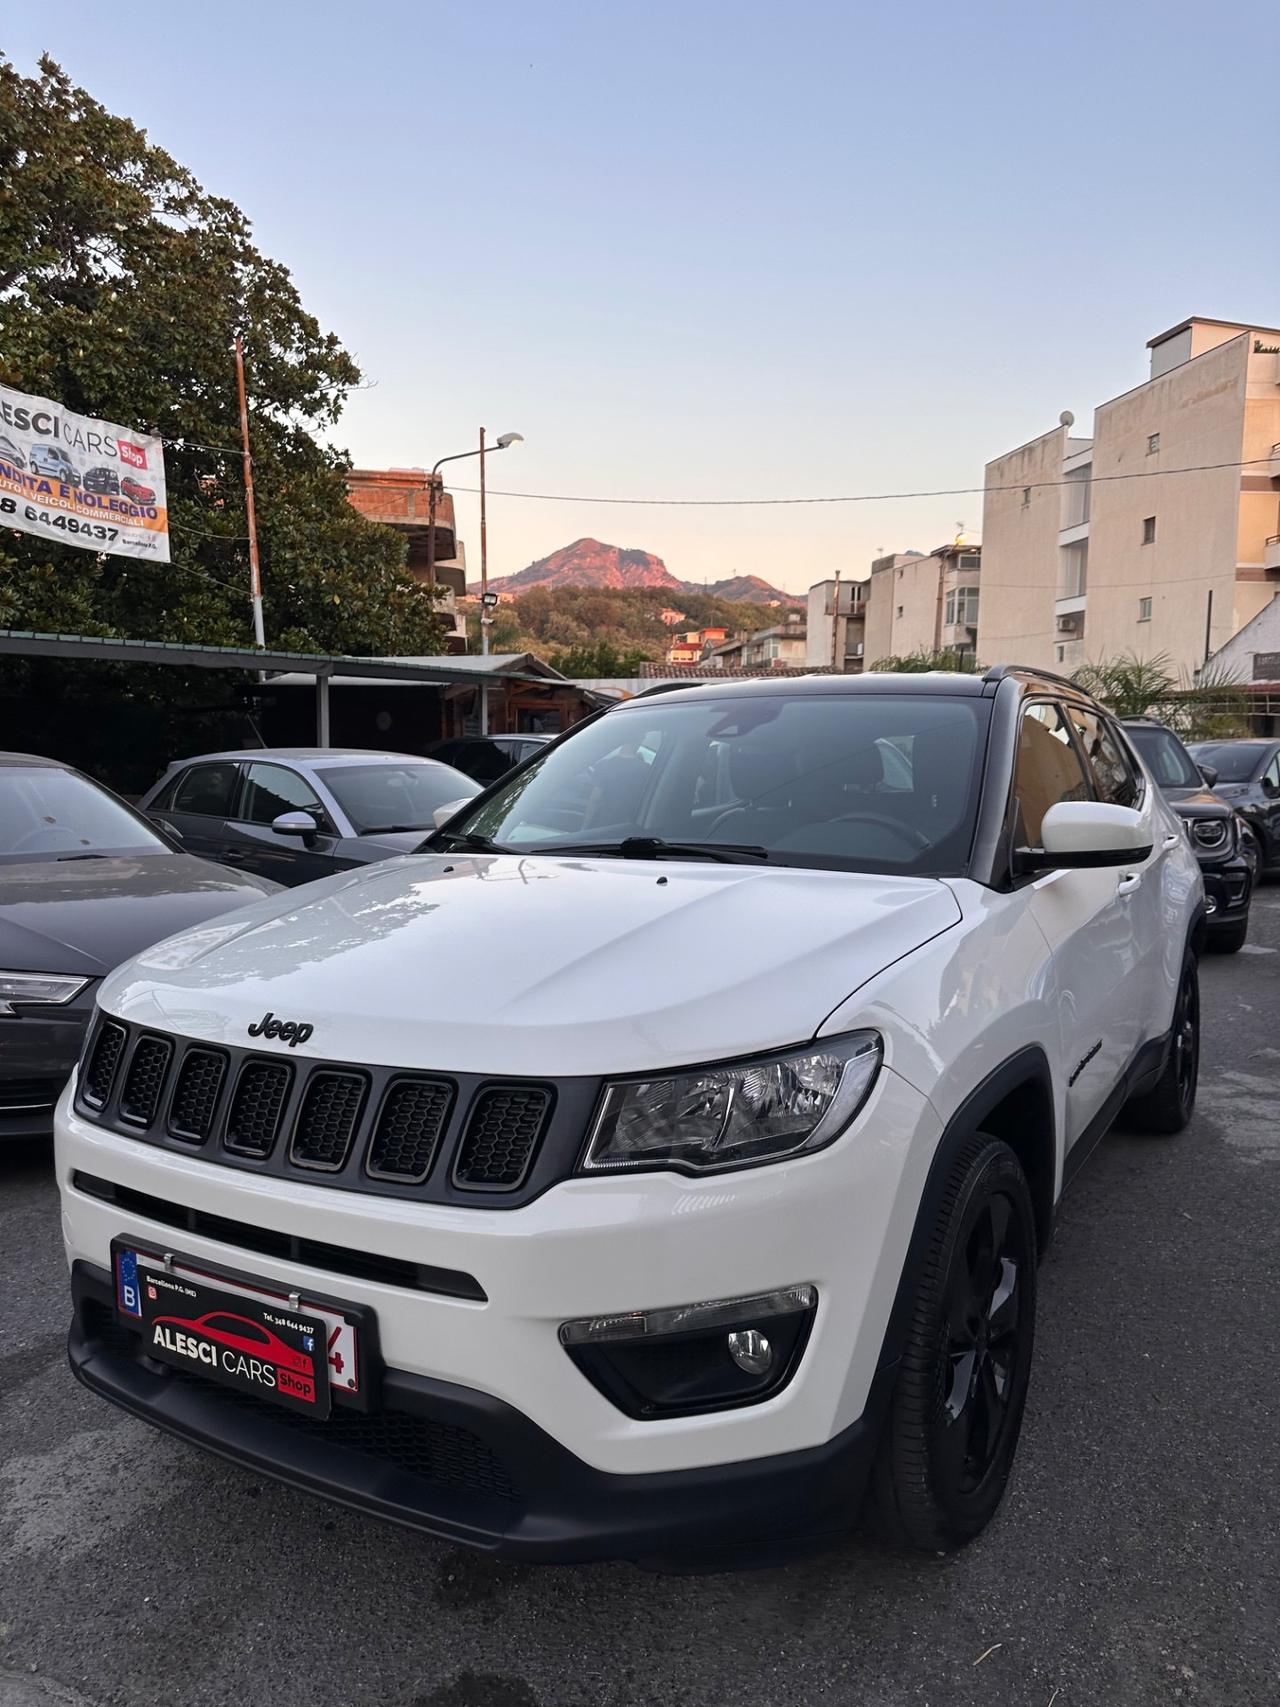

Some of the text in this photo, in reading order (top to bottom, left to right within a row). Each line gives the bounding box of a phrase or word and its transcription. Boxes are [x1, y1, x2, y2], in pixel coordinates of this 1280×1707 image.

[0, 400, 144, 467] ESCI CARS Shop
[31, 491, 75, 510] VEICOLI
[76, 504, 145, 527] COMMERCIALI
[60, 485, 71, 499] E
[74, 490, 158, 520] NOLEGGIO
[25, 506, 119, 541] 6449437
[248, 1012, 314, 1048] Jeep
[124, 1285, 135, 1307] B
[299, 1324, 314, 1334] 9437
[153, 1325, 312, 1396] ALESCI CARS Shop
